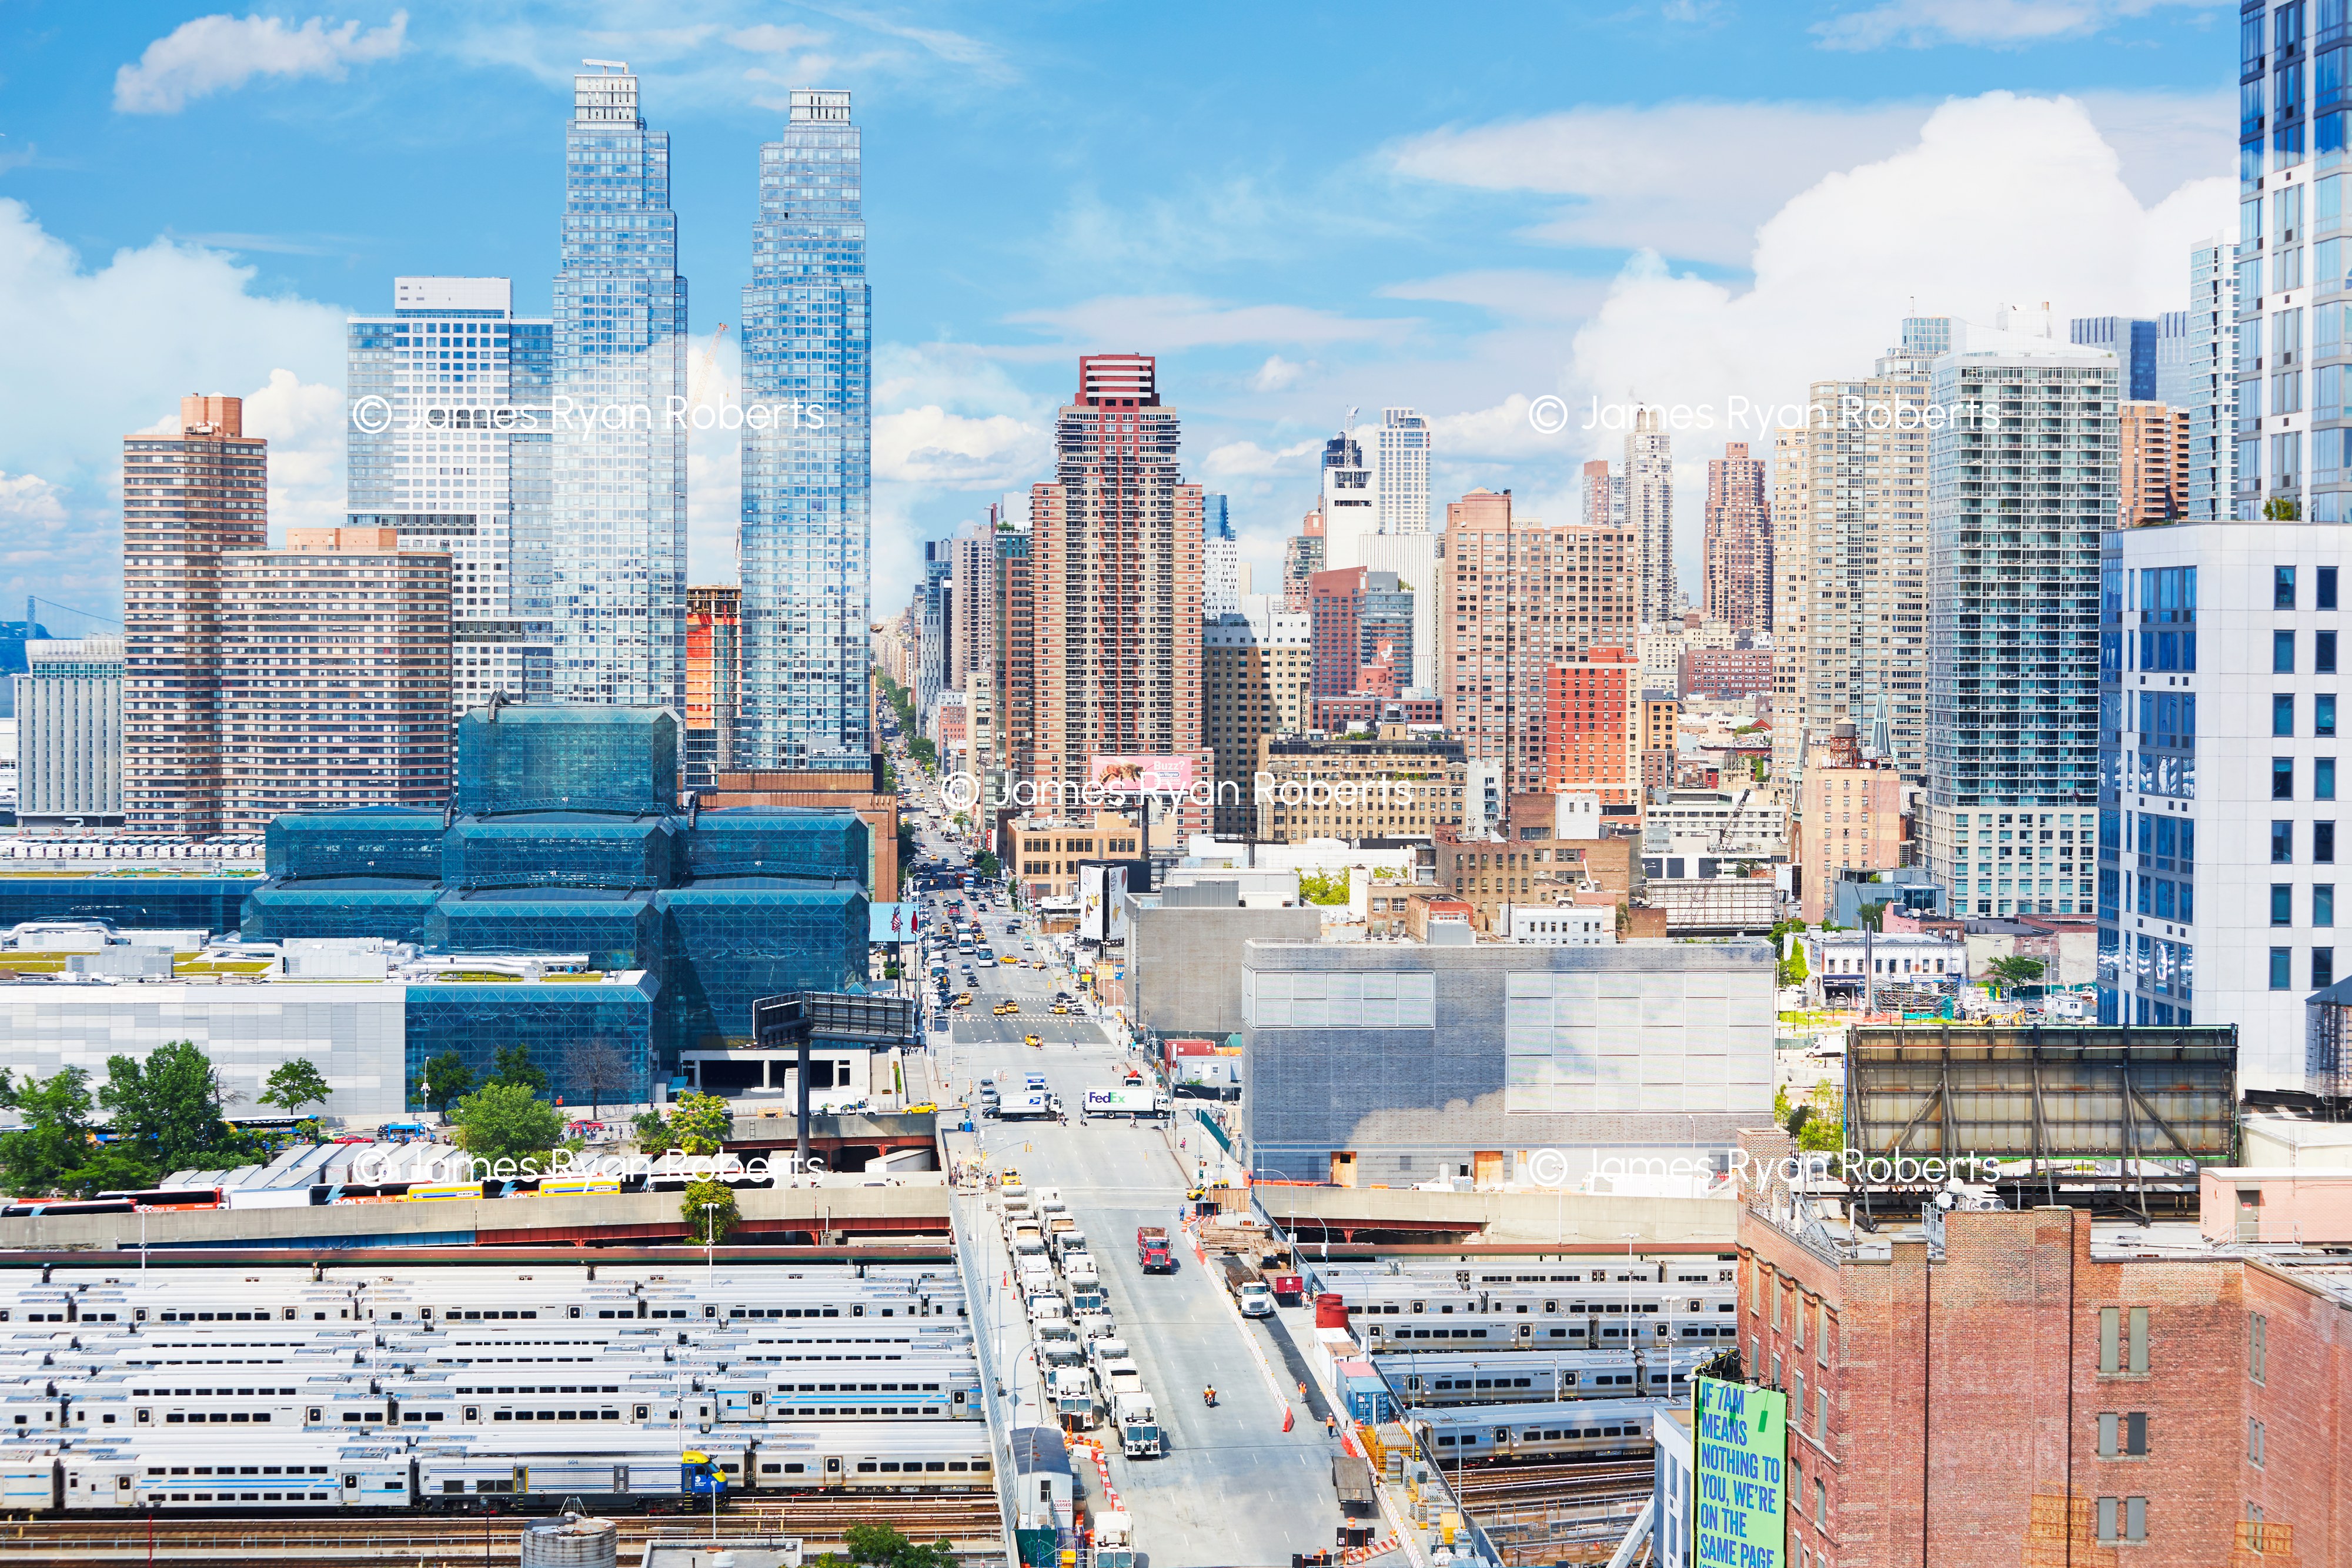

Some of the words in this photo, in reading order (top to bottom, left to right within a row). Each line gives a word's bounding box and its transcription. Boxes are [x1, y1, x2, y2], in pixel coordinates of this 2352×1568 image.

[1154, 760, 1185, 771] Buzz?
[1090, 1092, 1125, 1103] FedEx
[1702, 1382, 1713, 1408] IF
[1718, 1386, 1745, 1415] 7AM
[1702, 1412, 1747, 1446] MEANS
[1702, 1443, 1758, 1480] NOTHING
[1762, 1455, 1780, 1484] TO
[1701, 1472, 1729, 1505] YOU,
[1733, 1480, 1776, 1514] WE'RE
[1700, 1503, 1718, 1531] ON
[1722, 1507, 1747, 1538] THE
[1700, 1533, 1736, 1566] SAME
[1740, 1542, 1775, 1568] PAGE
